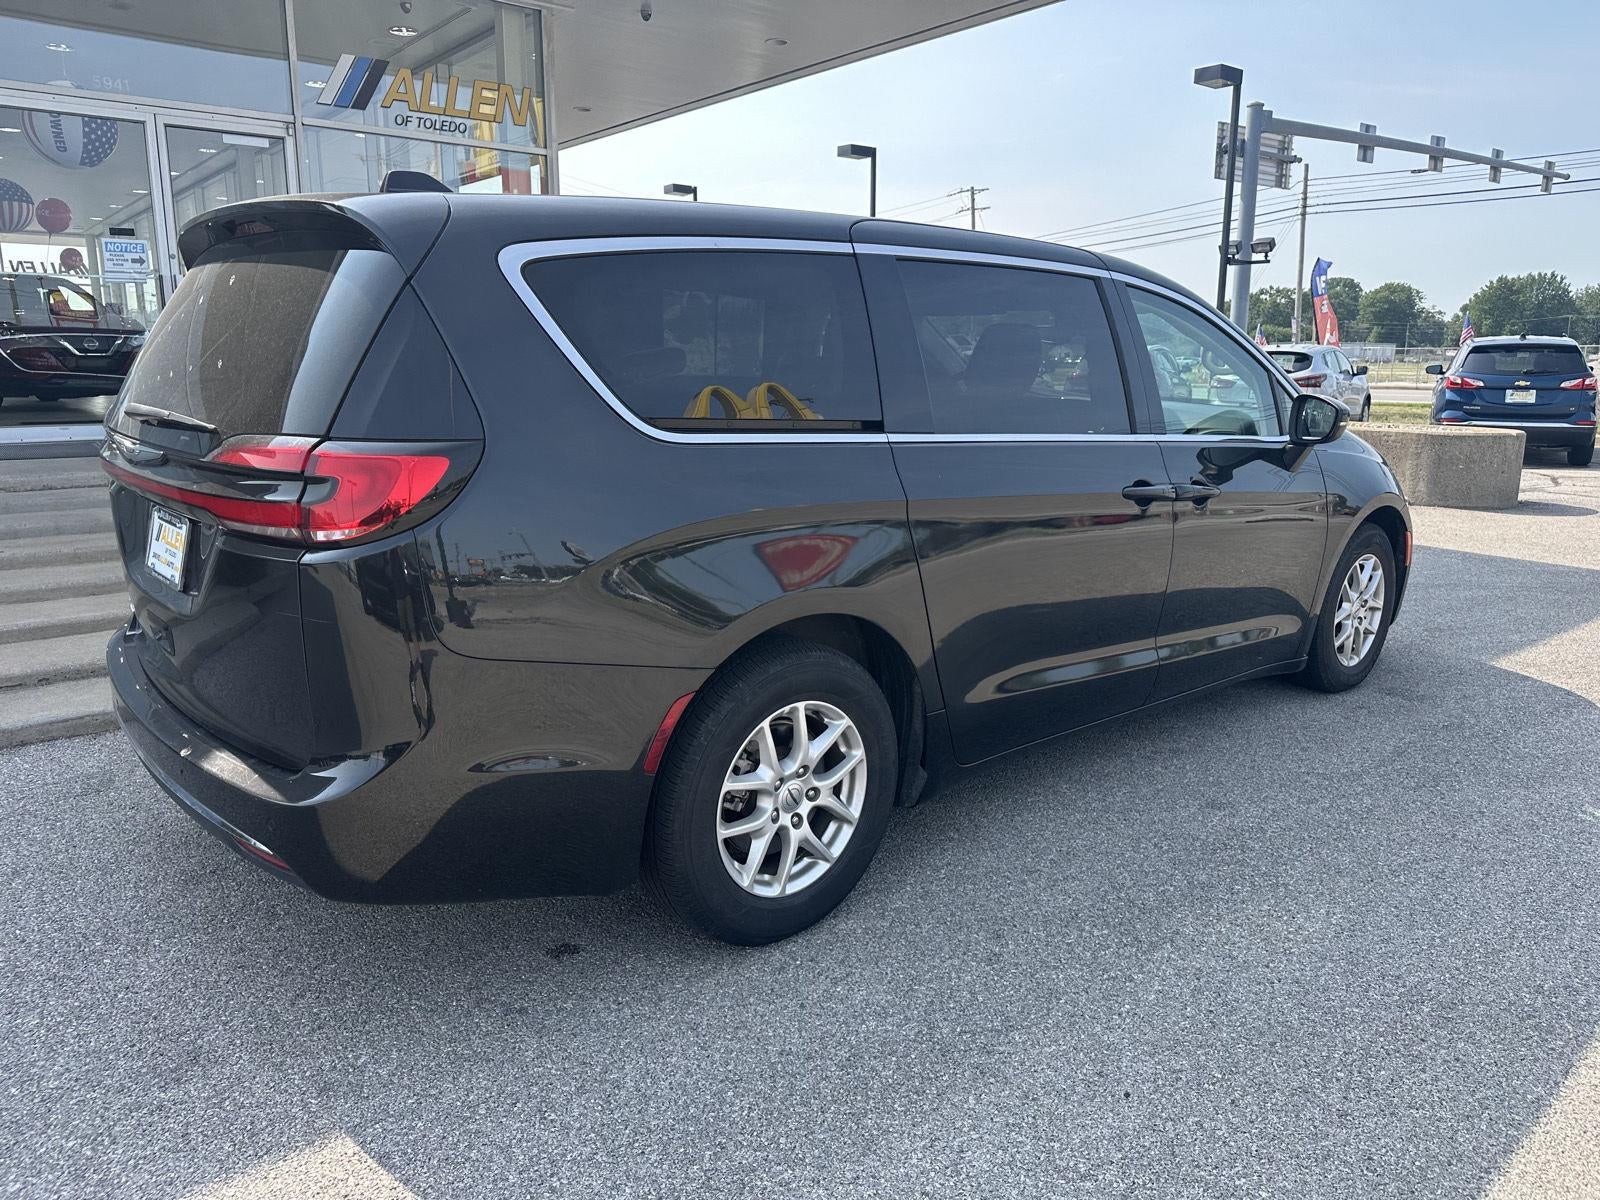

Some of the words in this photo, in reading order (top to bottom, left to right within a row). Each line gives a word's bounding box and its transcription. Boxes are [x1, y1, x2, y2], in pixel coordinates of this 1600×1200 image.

[92, 75, 129, 91] 5941
[381, 68, 532, 126] ALLEN
[395, 114, 412, 126] OF
[417, 117, 467, 134] TOLEDO
[107, 243, 143, 253] NOTICE
